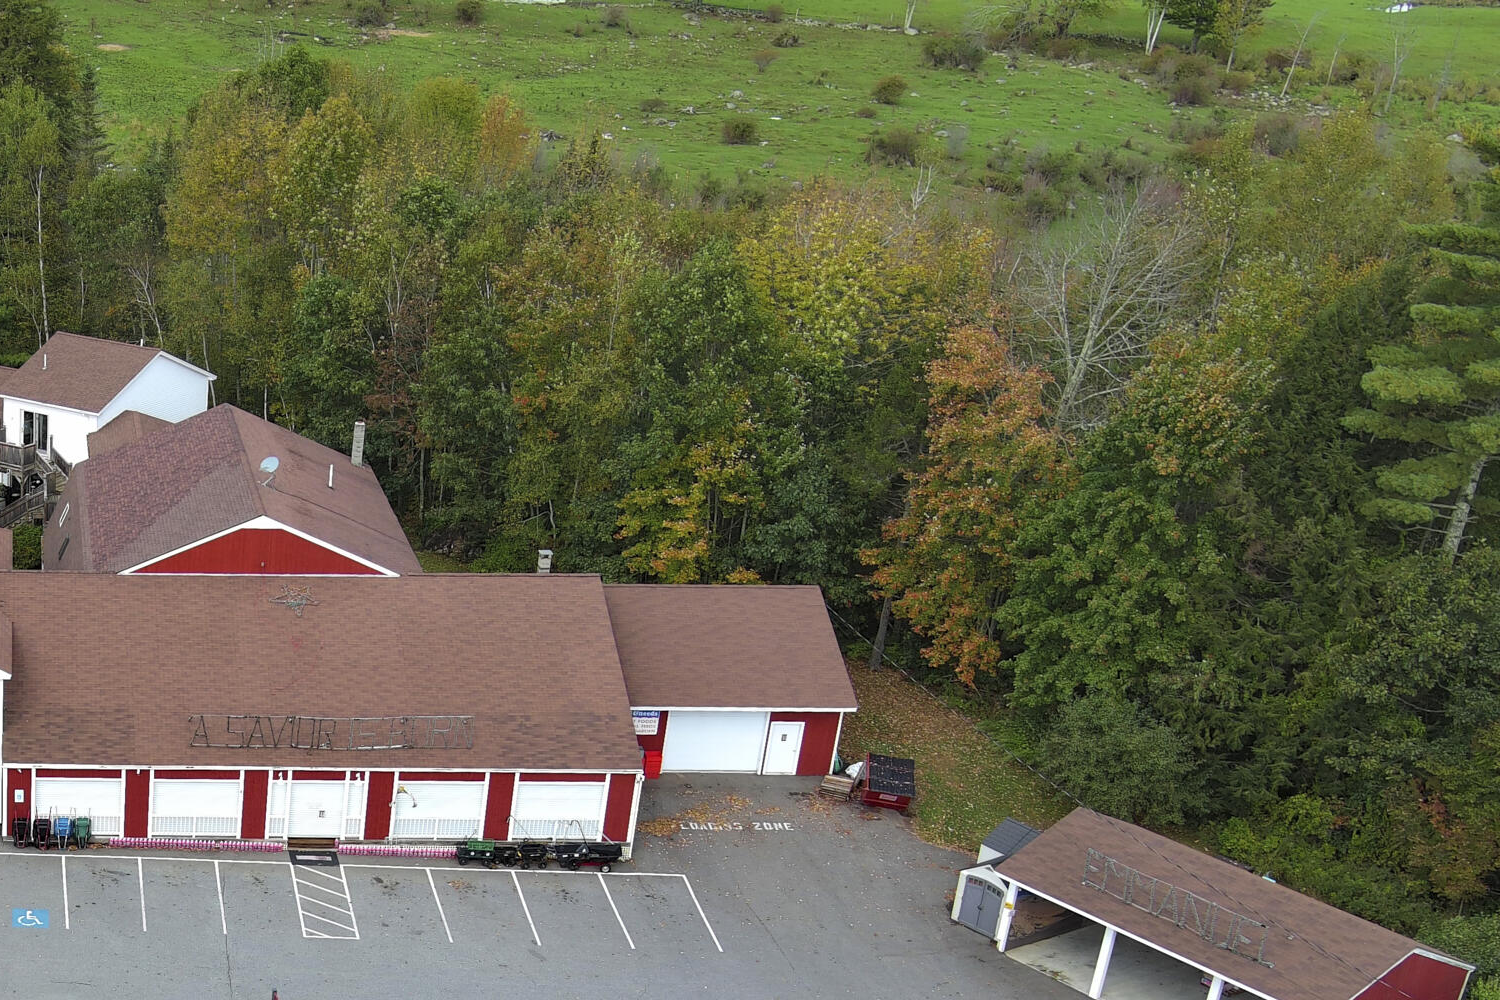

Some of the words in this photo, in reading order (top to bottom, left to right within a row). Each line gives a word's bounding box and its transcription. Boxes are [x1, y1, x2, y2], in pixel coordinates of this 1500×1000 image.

[189, 715, 209, 748] A
[752, 822, 794, 831] ZONE
[1082, 848, 1276, 969] EMMANUEL
